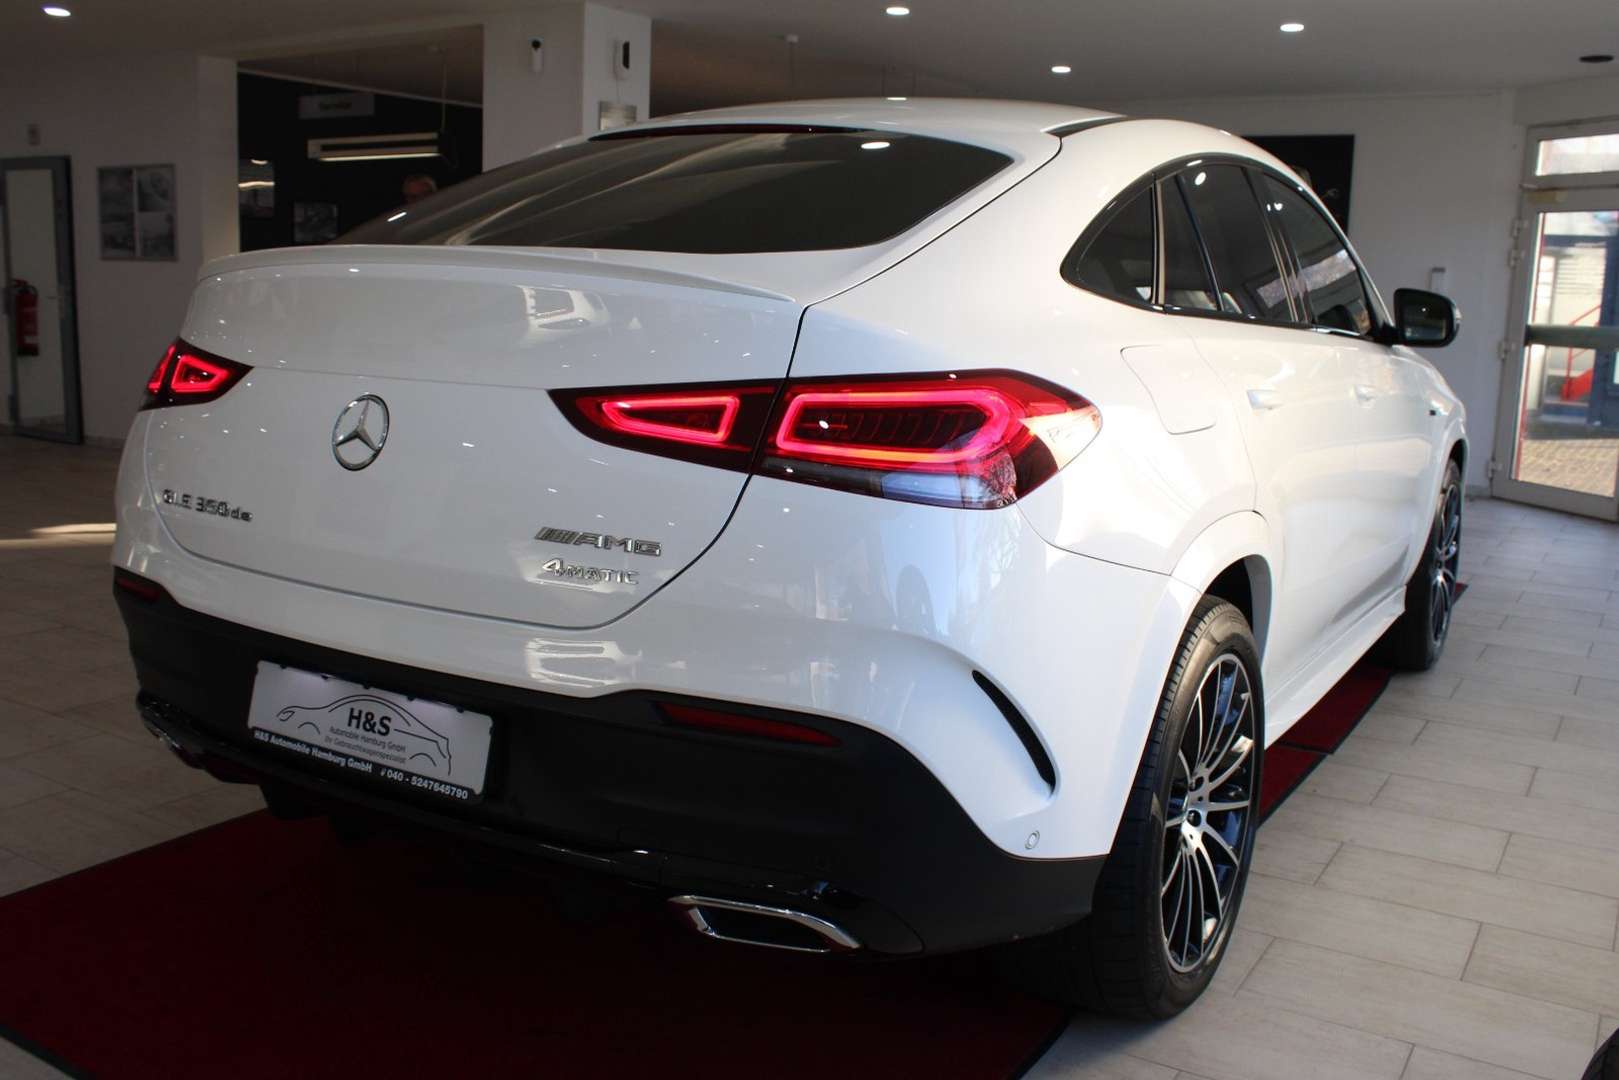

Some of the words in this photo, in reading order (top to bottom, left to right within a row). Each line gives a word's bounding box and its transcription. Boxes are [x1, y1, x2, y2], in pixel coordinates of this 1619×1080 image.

[541, 557, 640, 586] 4MATIC
[347, 707, 392, 736] H&S
[254, 731, 270, 743] H&S
[270, 736, 311, 756] Automobile
[311, 747, 346, 767] Hamburg
[347, 758, 373, 773] GmbH
[329, 726, 359, 740] Automobile
[360, 735, 386, 749] Hamburg
[387, 741, 406, 752] GmbH
[387, 769, 404, 782] 040
